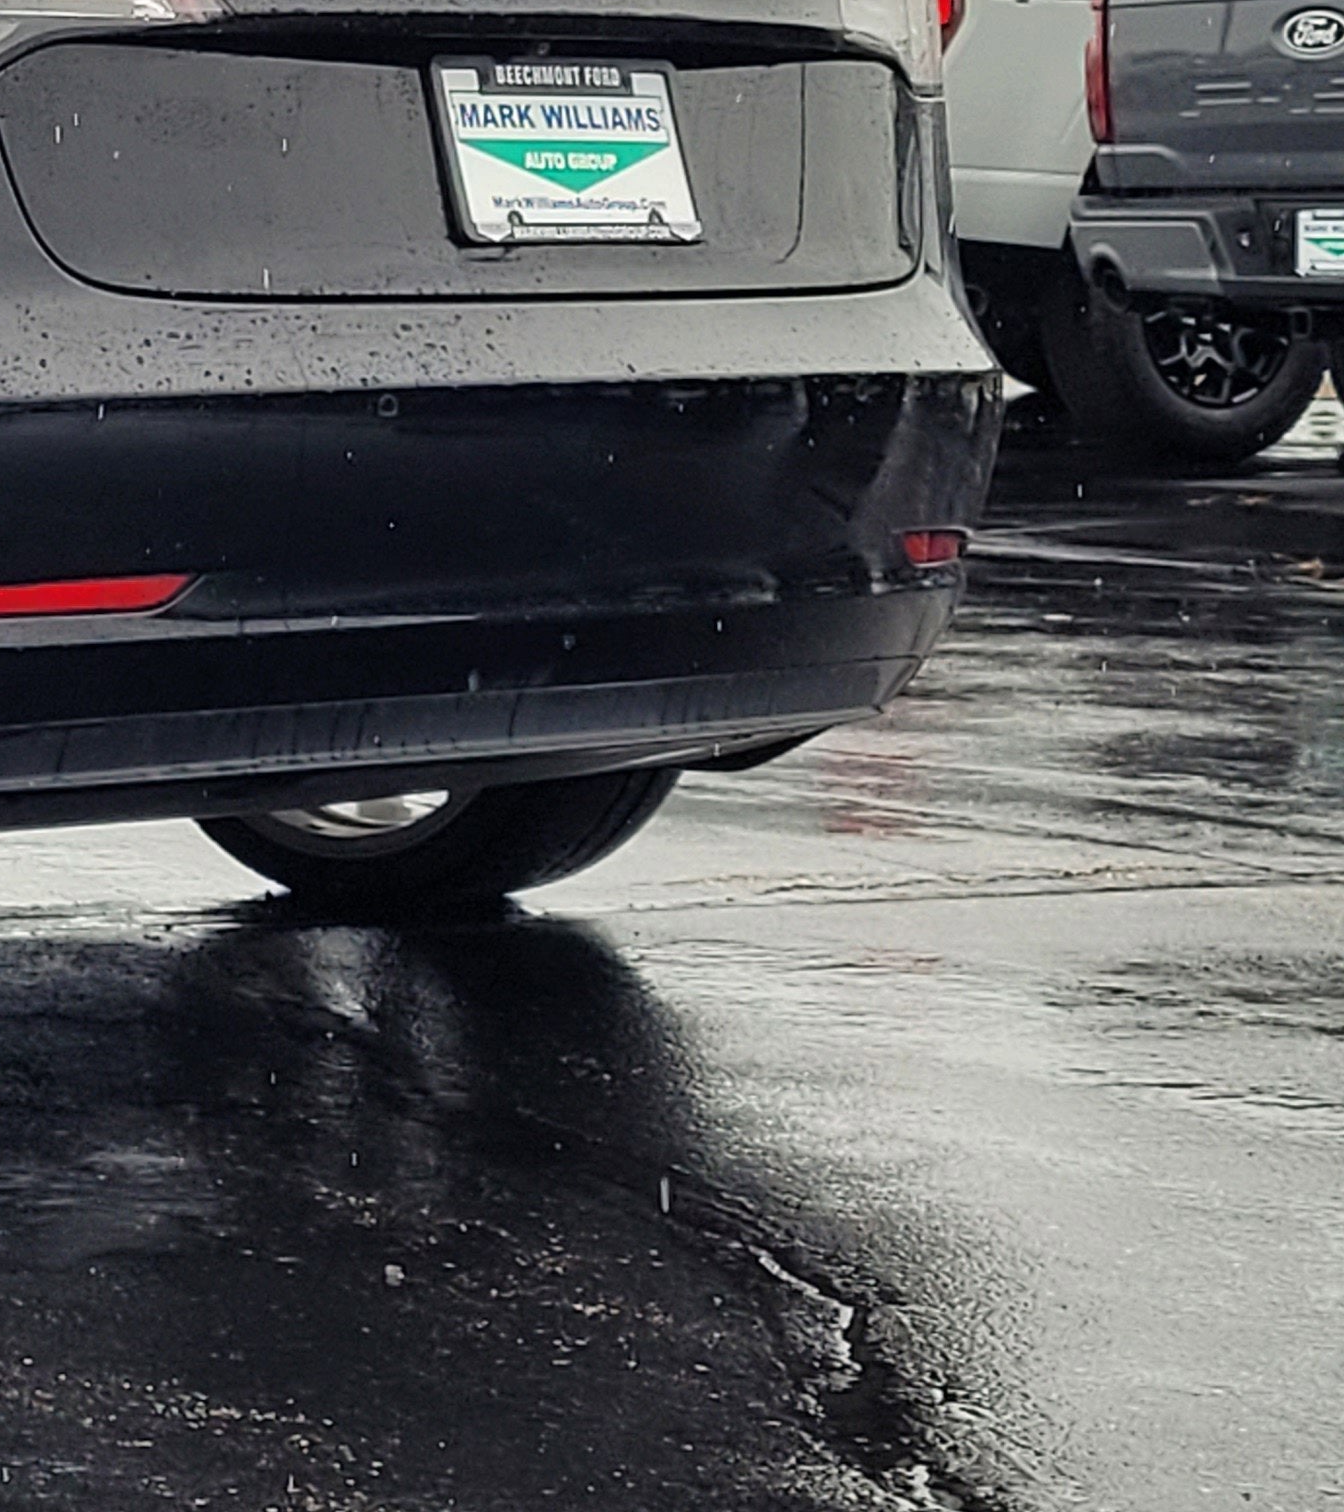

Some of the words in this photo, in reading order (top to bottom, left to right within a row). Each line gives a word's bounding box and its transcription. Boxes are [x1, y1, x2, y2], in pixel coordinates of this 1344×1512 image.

[1293, 17, 1339, 46] Ford
[494, 65, 580, 86] BEECHMONT
[583, 66, 621, 87] FORD
[459, 103, 536, 129] MARK
[540, 104, 662, 132] WILLIAMS
[525, 151, 566, 170] AUTO
[567, 152, 617, 171] GROUP
